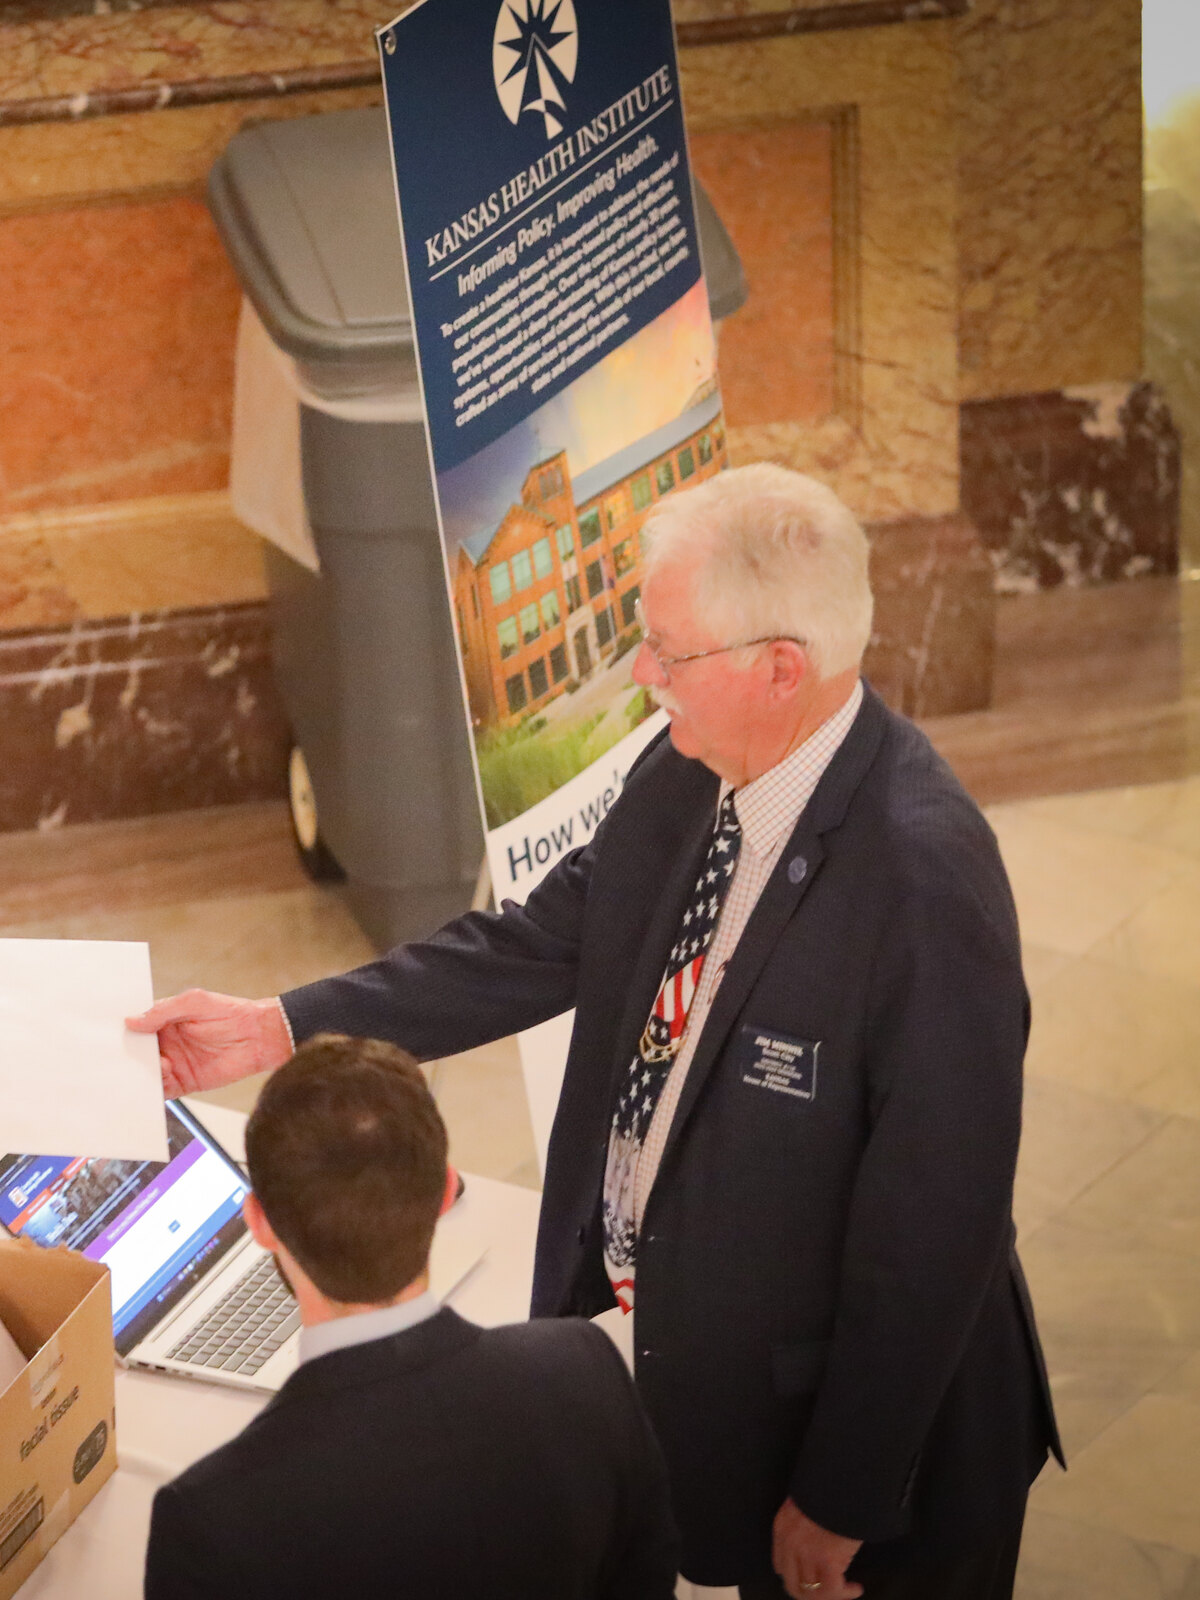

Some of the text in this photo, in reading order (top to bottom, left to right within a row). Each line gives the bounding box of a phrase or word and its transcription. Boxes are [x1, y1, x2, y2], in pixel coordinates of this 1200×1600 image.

[424, 63, 673, 268] KANSAS HEALTH INSTITUTE
[457, 134, 660, 298] Informing Policy. Improving Health.
[507, 770, 627, 881] How we'
[19, 1415, 49, 1462] facial
[50, 1385, 80, 1427] tissue
